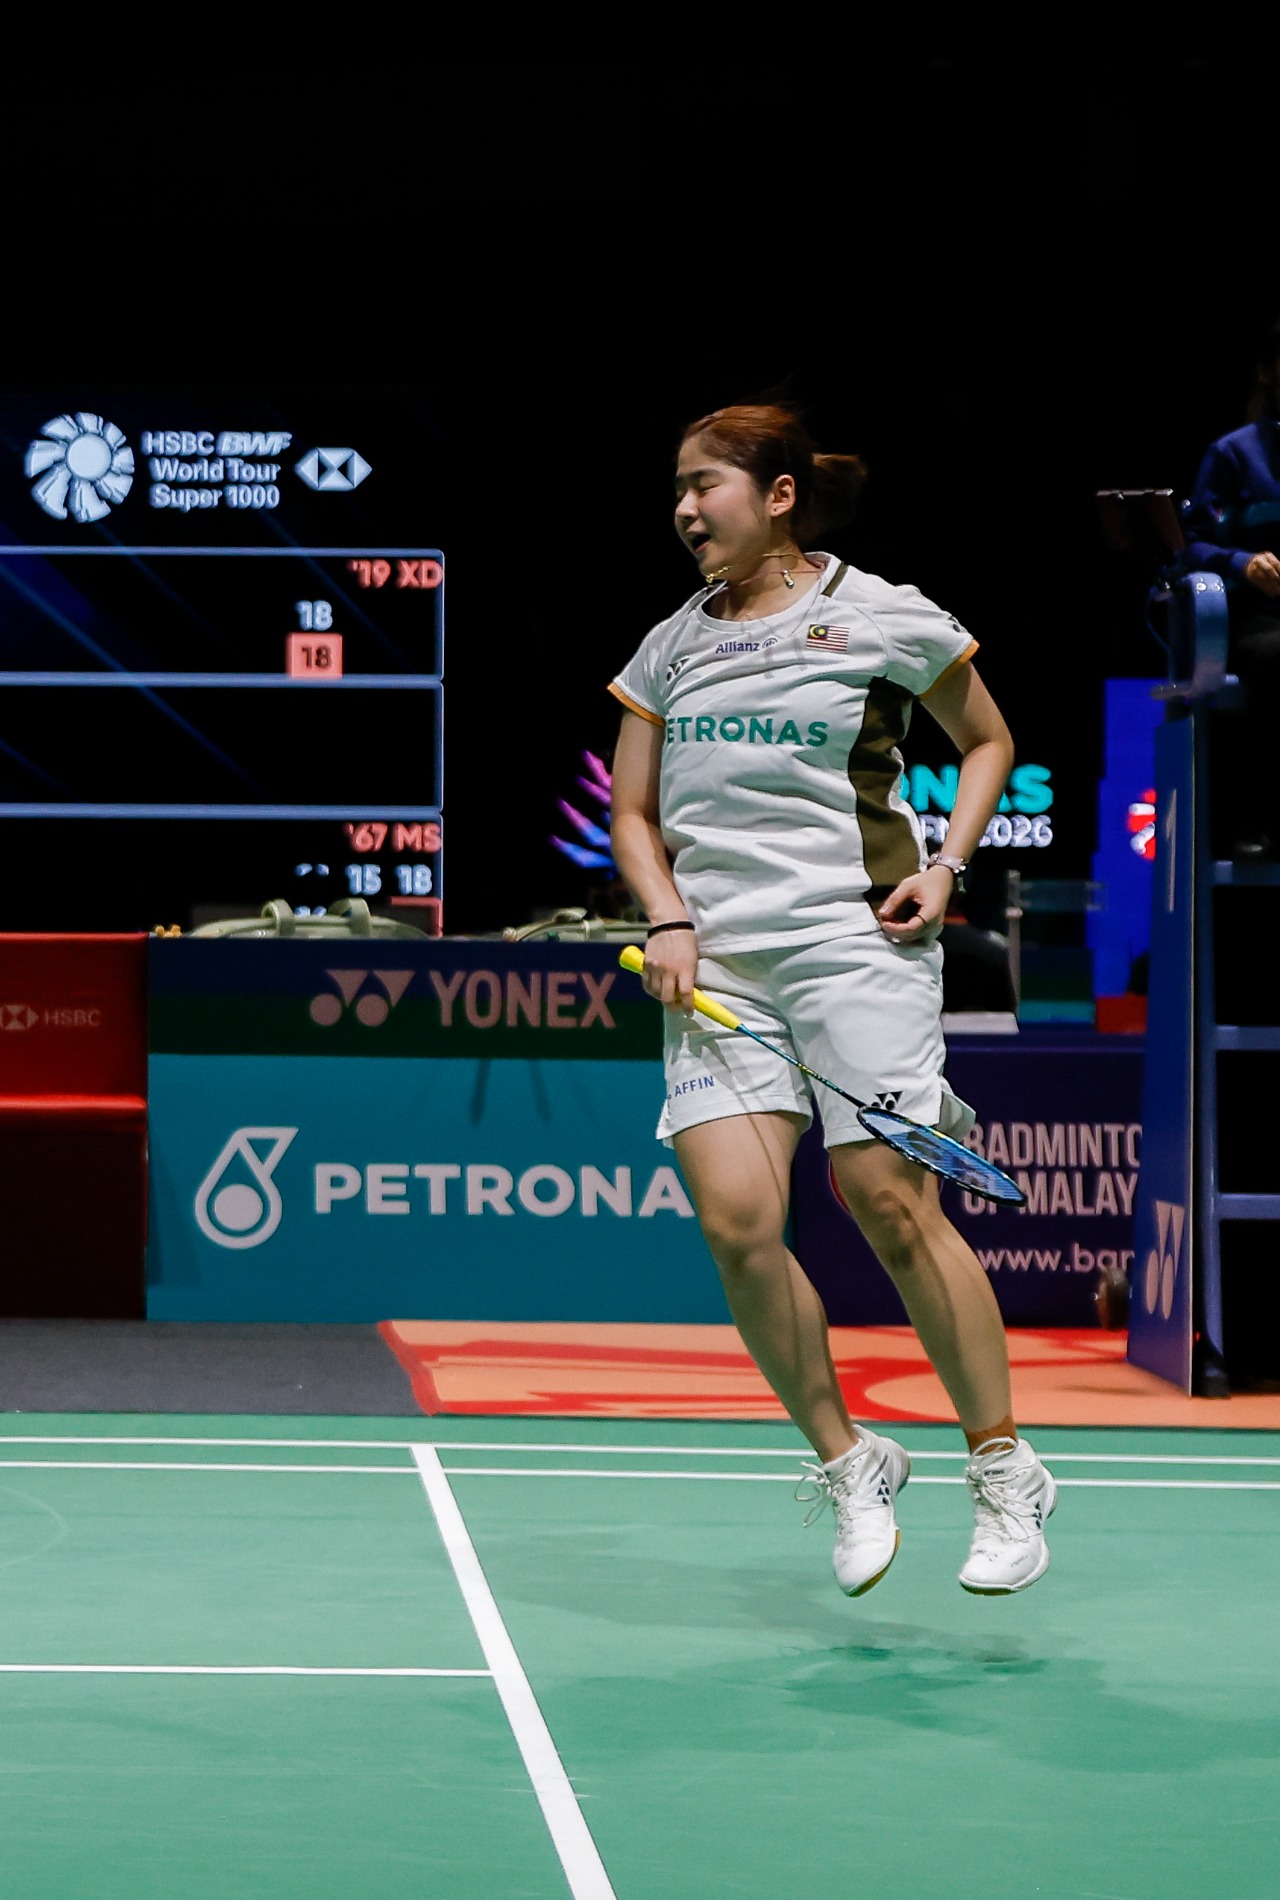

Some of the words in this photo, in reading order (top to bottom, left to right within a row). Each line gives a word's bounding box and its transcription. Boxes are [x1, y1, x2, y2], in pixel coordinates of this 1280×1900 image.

[142, 431, 215, 455] HSBC
[218, 431, 292, 456] BWF
[149, 457, 224, 482] World
[225, 457, 281, 482] Tour
[150, 483, 222, 512] Super
[224, 484, 280, 509] 1000
[347, 558, 391, 588] '19
[396, 559, 443, 589] XD
[295, 599, 333, 631] 18
[300, 645, 333, 669] 18
[715, 639, 761, 655] Allianz
[666, 716, 829, 747] ETRONAS
[342, 822, 389, 853] '67
[391, 822, 443, 853] MS
[978, 814, 1054, 848] 026
[344, 863, 383, 896] 15
[394, 863, 433, 896] 18
[429, 970, 618, 1028] YONEX
[44, 1008, 102, 1027] HSBC
[674, 1075, 715, 1097] AFFIN
[314, 1163, 696, 1217] PETRONA
[1017, 1170, 1139, 1216] MALAY
